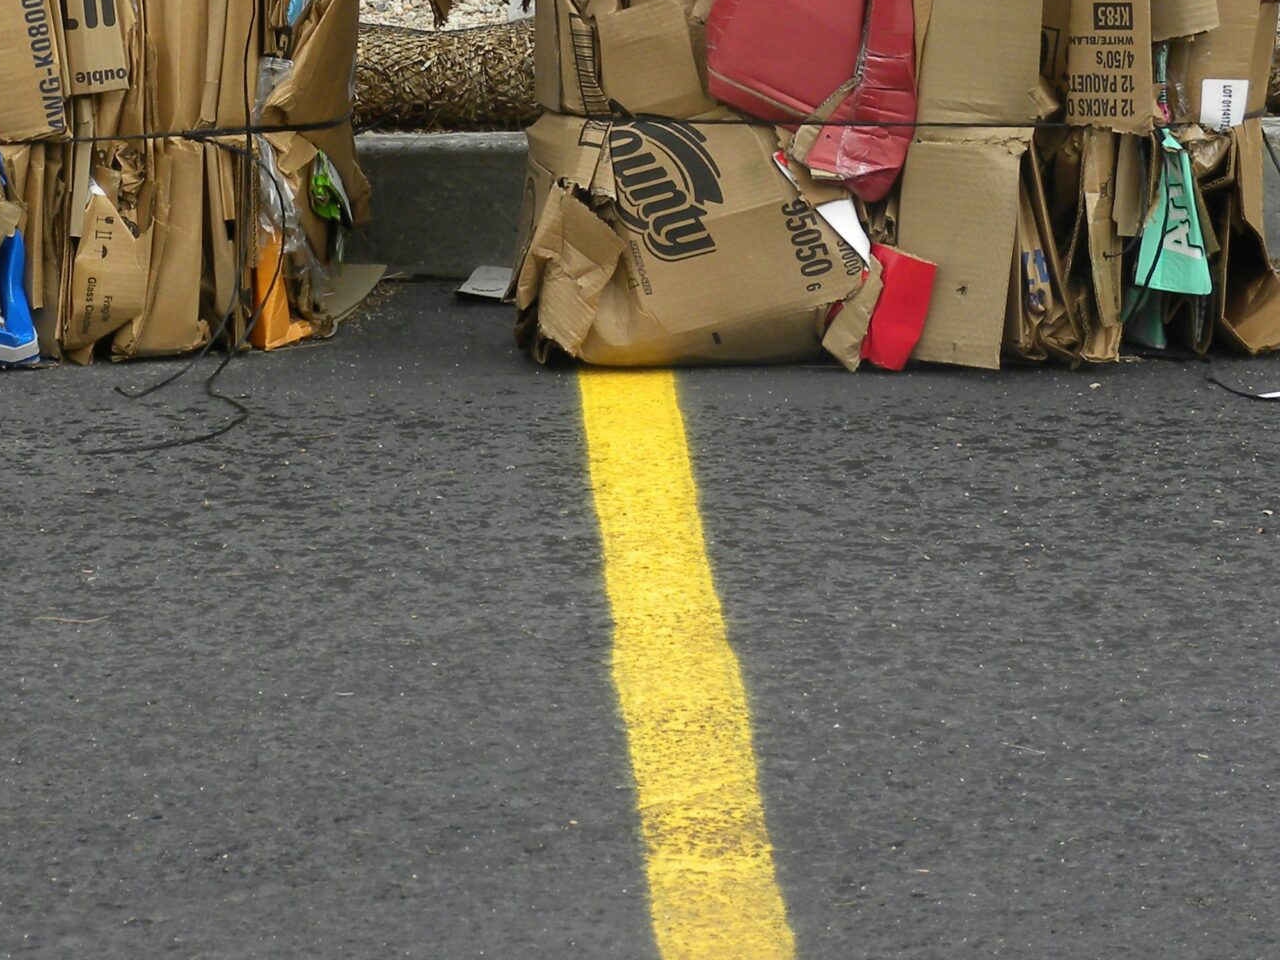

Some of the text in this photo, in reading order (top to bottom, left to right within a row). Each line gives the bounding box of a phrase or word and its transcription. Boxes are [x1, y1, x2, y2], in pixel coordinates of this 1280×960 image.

[1098, 6, 1130, 26] KF85
[1096, 50, 1135, 69] 4/50's
[1121, 75, 1135, 93] 12
[1079, 99, 1117, 117] PACKS
[1121, 99, 1135, 117] 12
[781, 199, 833, 277] 95050
[85, 277, 97, 303] Glass
